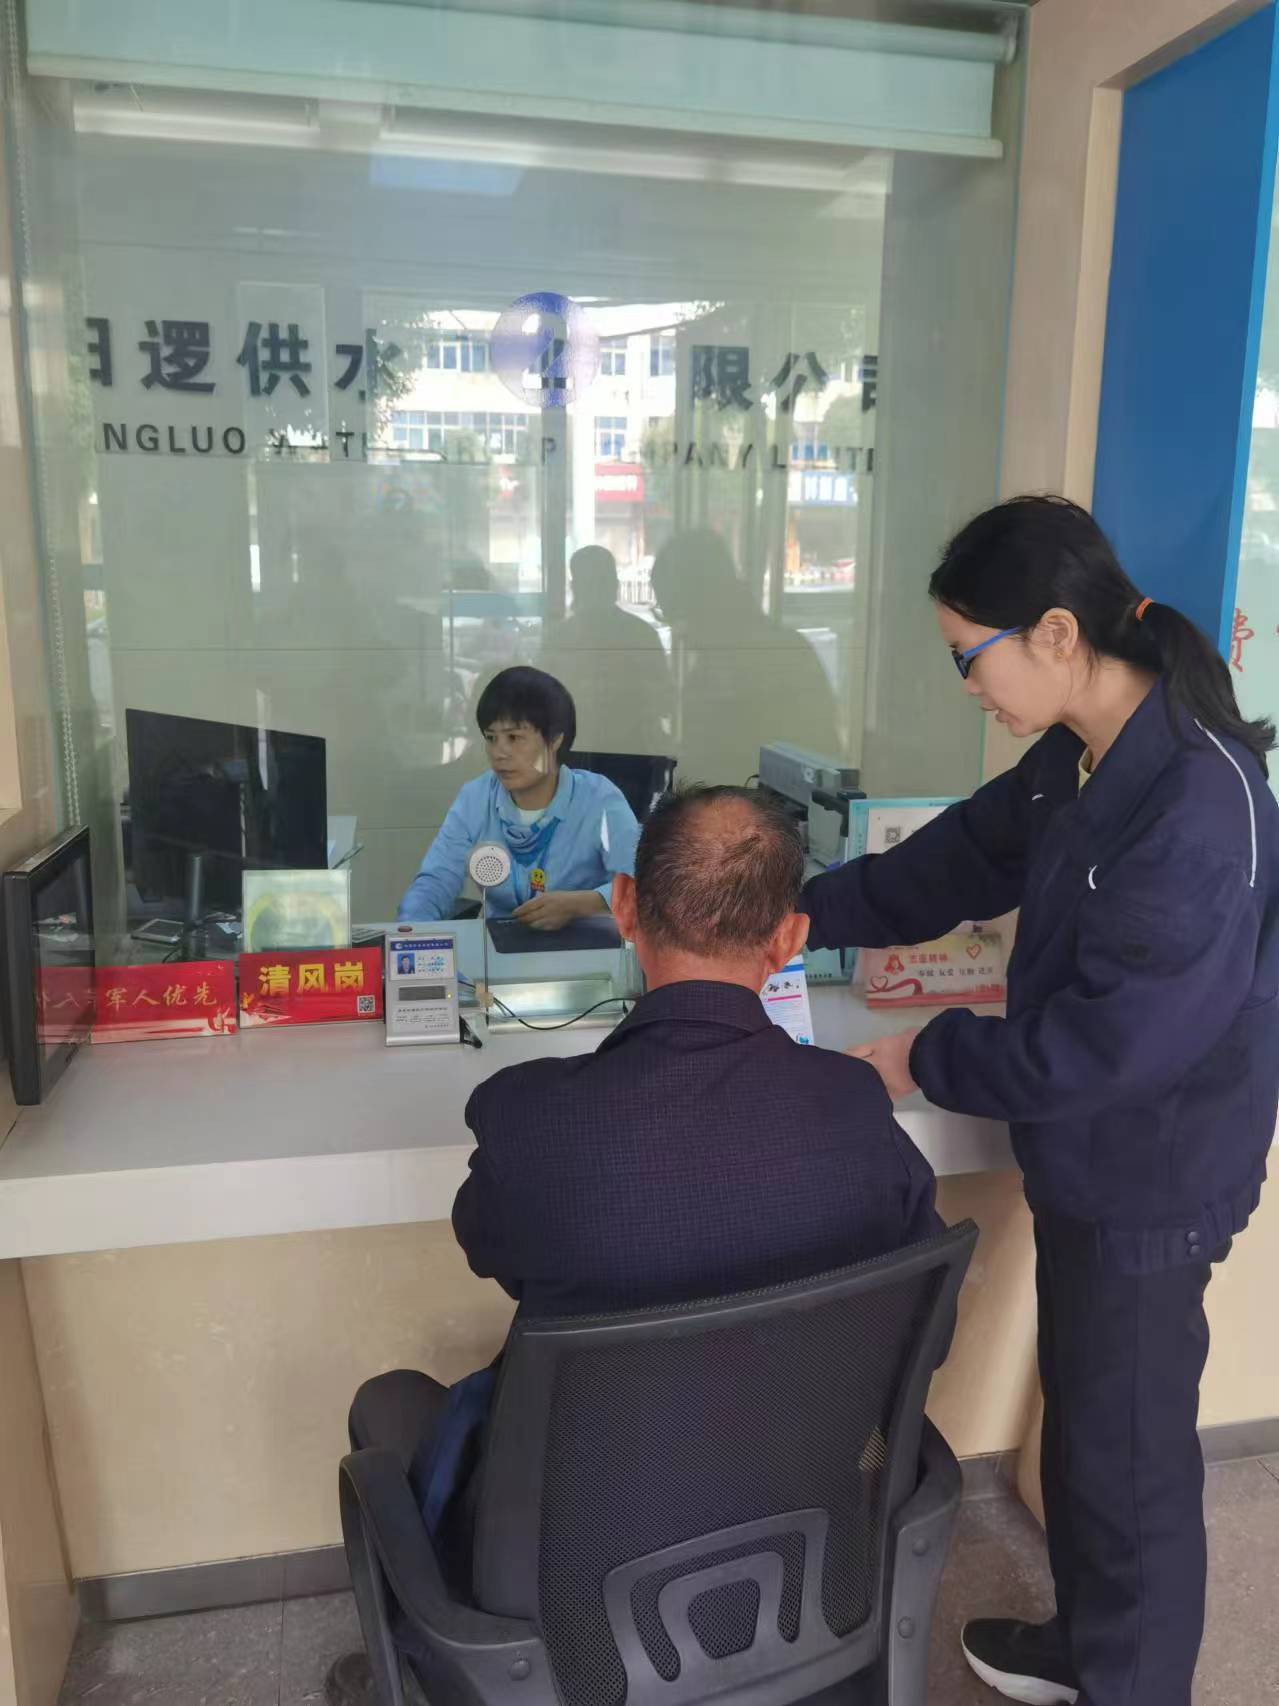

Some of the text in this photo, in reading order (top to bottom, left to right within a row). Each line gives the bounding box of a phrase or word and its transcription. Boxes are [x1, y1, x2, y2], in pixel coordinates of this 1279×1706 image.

[689, 344, 877, 412] 限公
[257, 961, 366, 996] 清风岗
[104, 980, 218, 1016] 军人优先
